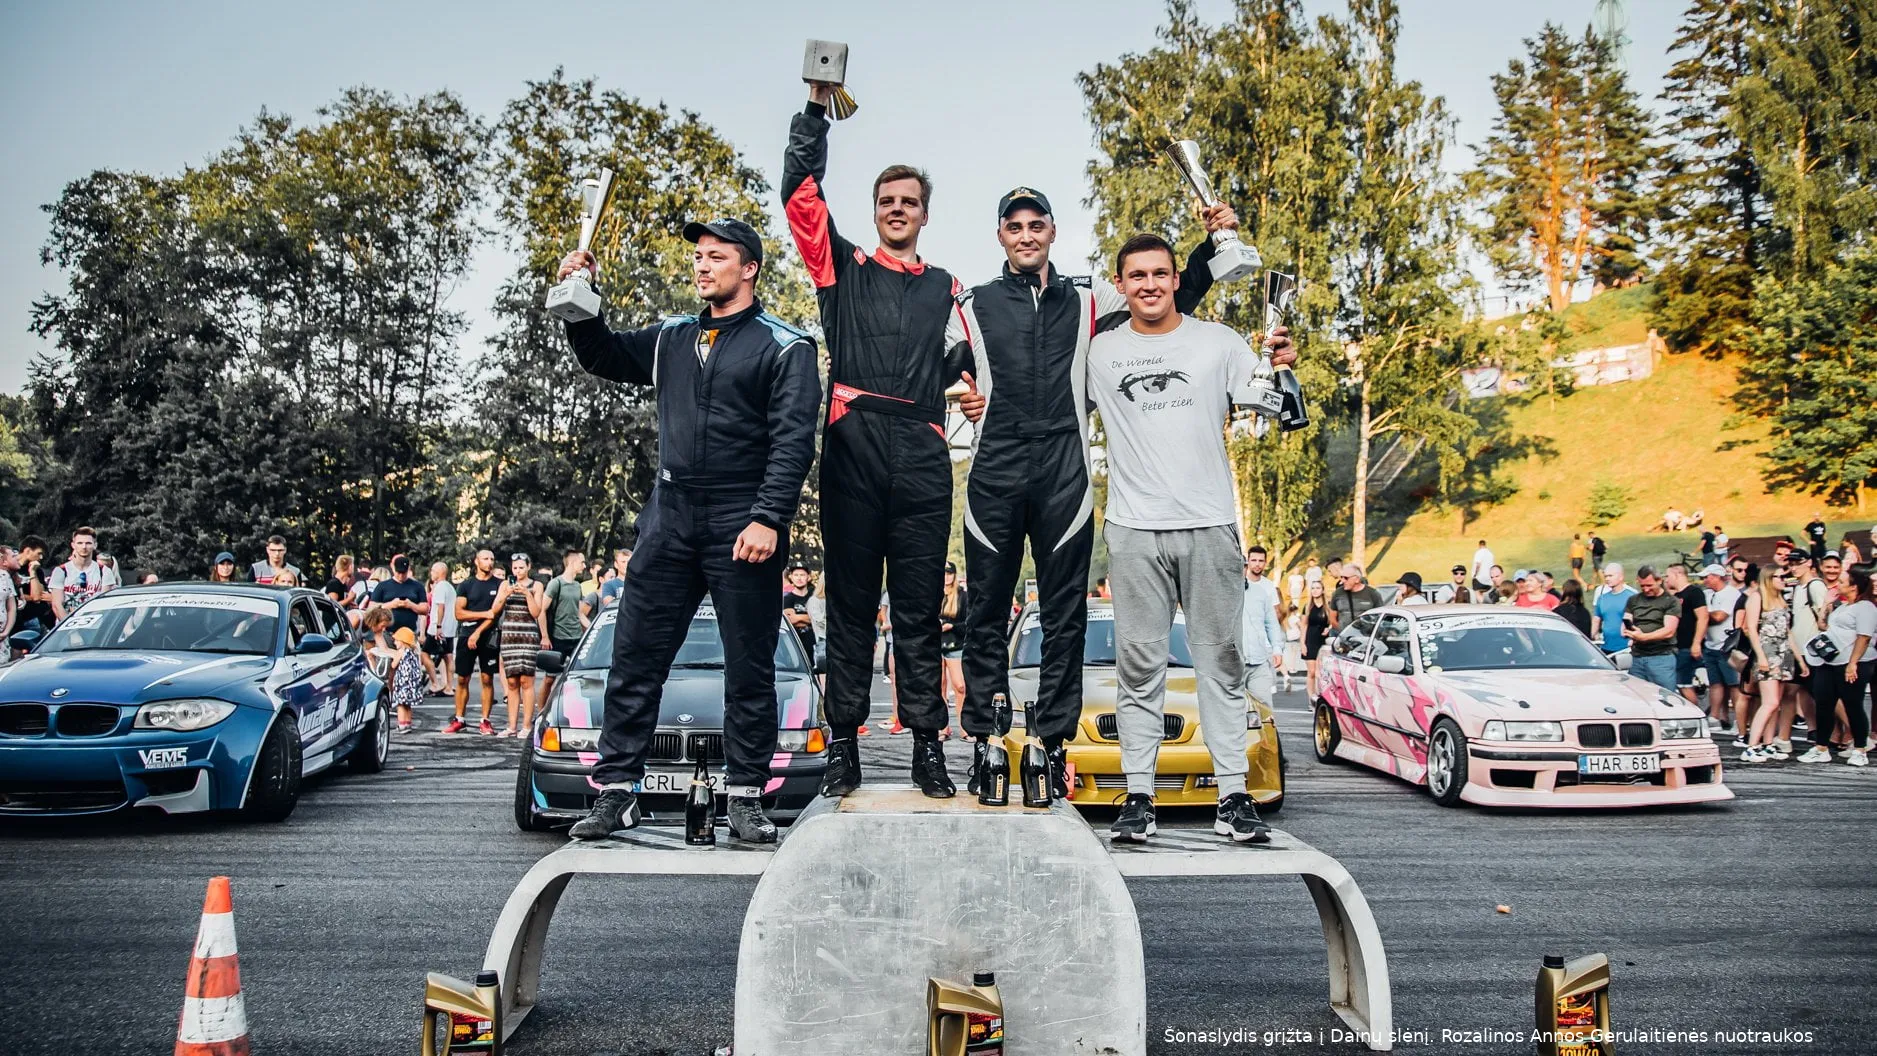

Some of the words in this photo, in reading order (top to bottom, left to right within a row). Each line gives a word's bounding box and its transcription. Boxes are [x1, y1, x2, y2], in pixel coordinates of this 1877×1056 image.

[1111, 360, 1124, 369] De
[1127, 355, 1165, 367] Wereld
[1141, 401, 1168, 412] Beter
[1171, 395, 1194, 408] zien
[1419, 621, 1444, 631] 59
[1590, 757, 1622, 771] HAR
[1632, 757, 1656, 771] 681
[644, 775, 683, 791] CRL
